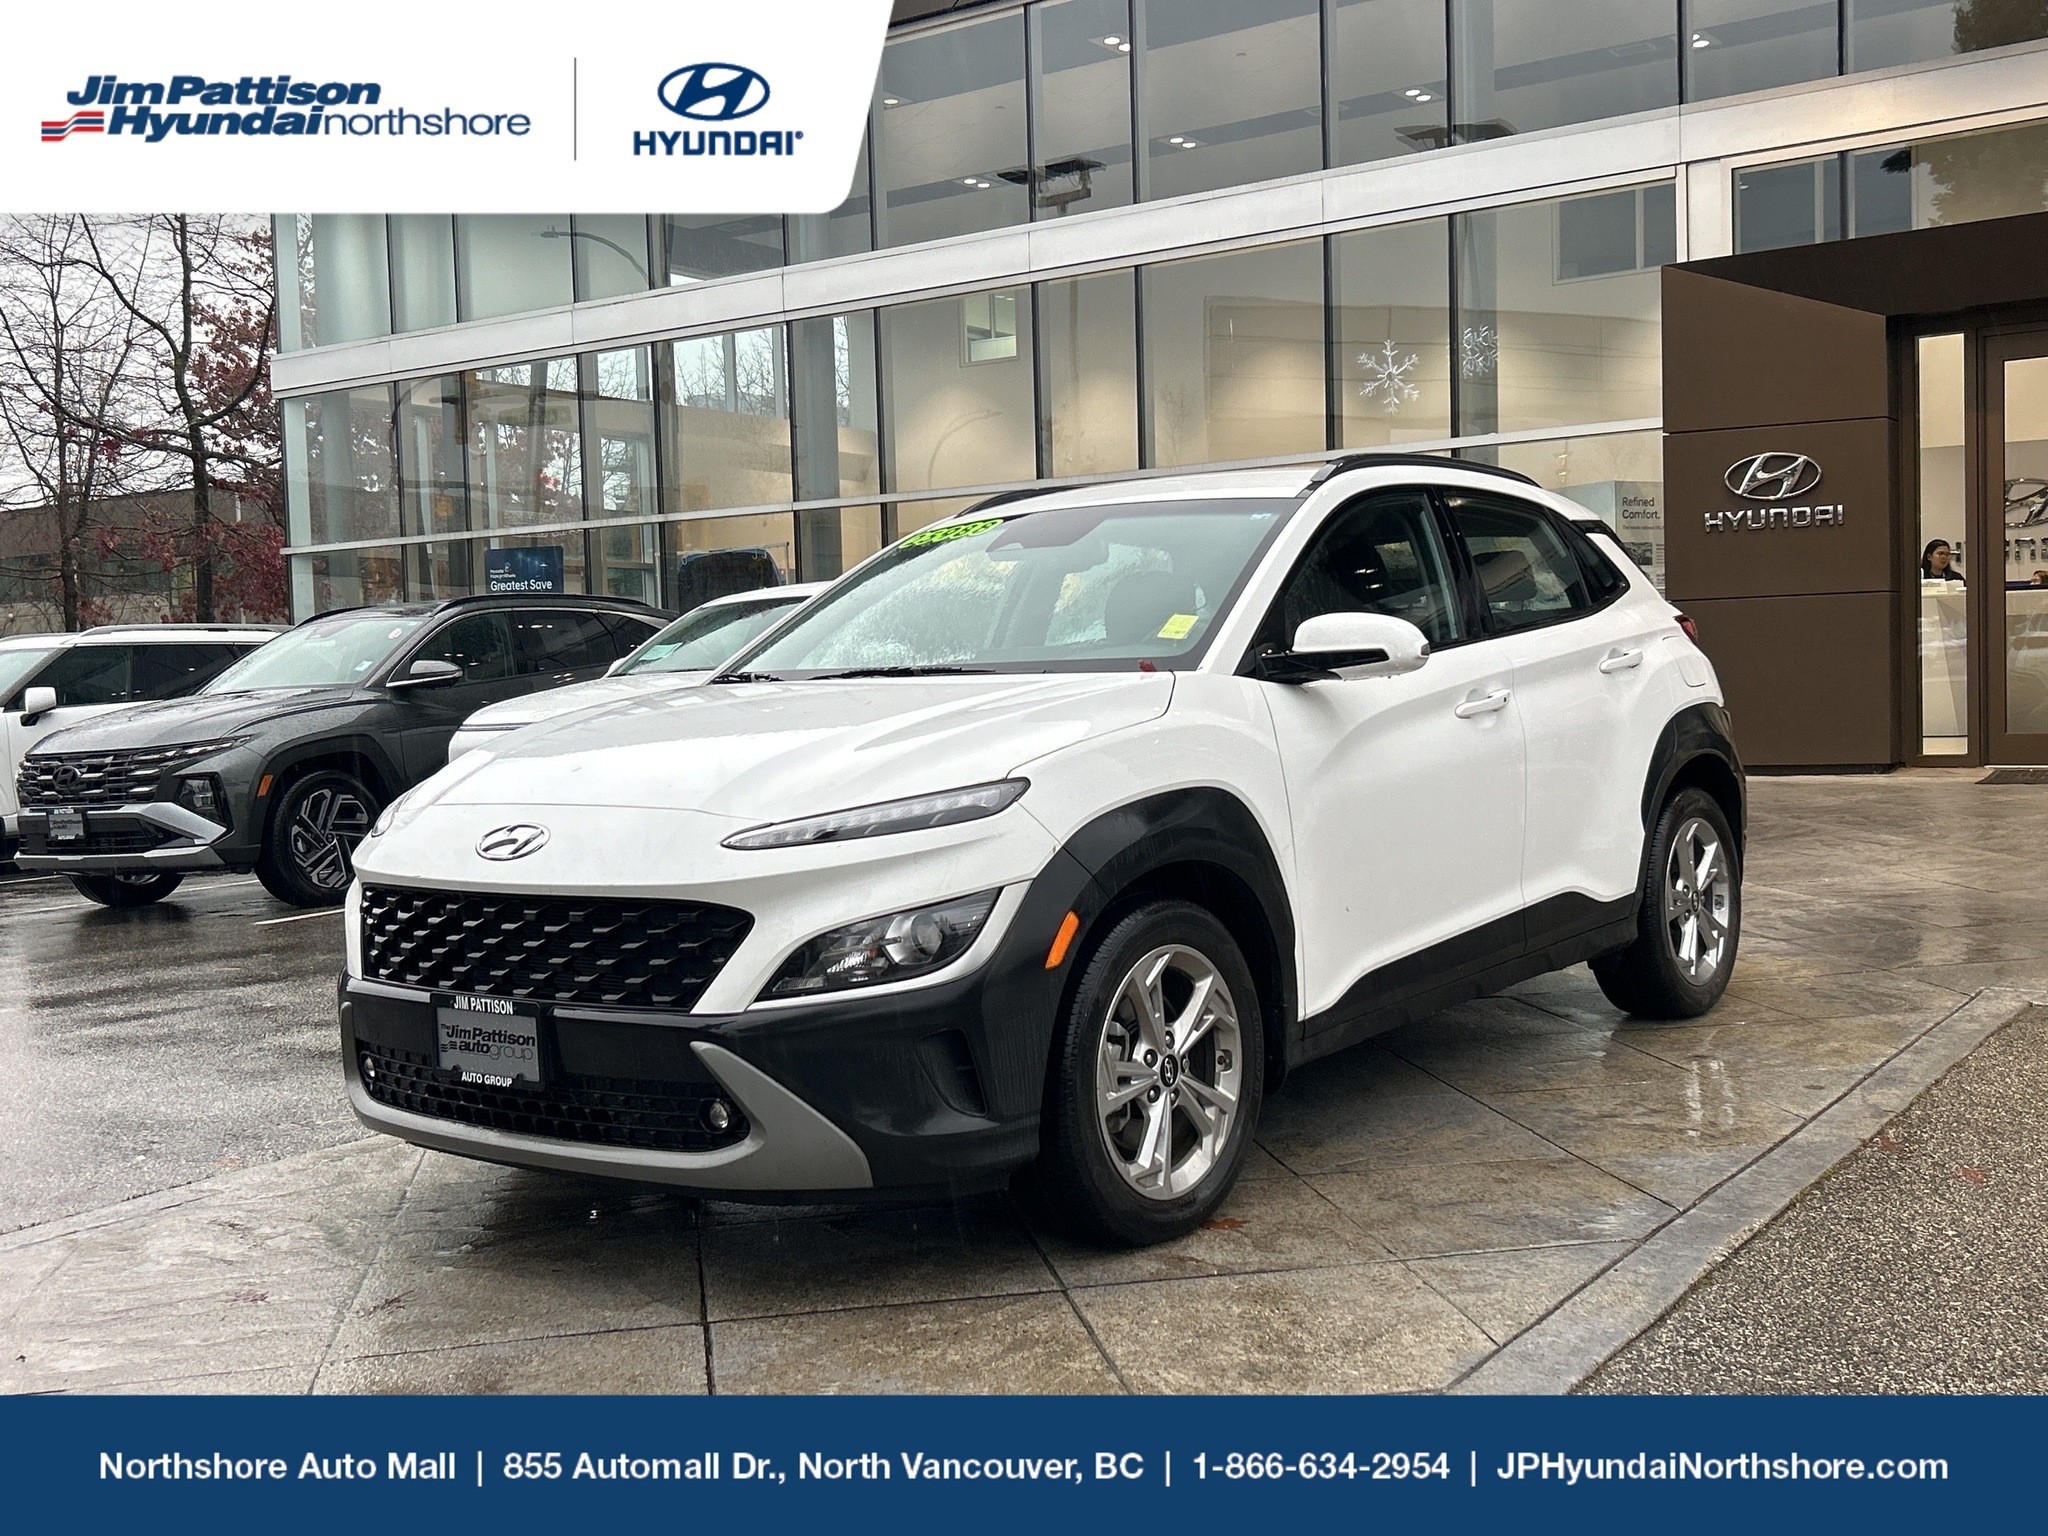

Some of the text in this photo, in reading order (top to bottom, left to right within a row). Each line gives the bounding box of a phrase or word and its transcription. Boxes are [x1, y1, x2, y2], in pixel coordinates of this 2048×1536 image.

[1622, 496, 1655, 507] Refined
[1621, 509, 1661, 520] Comfort.
[1704, 504, 1844, 533] HYUNDAI
[490, 579, 553, 591] Greatest Save
[453, 995, 513, 1015] JIM PATTISON
[461, 1071, 513, 1087] AUTO GROUP
